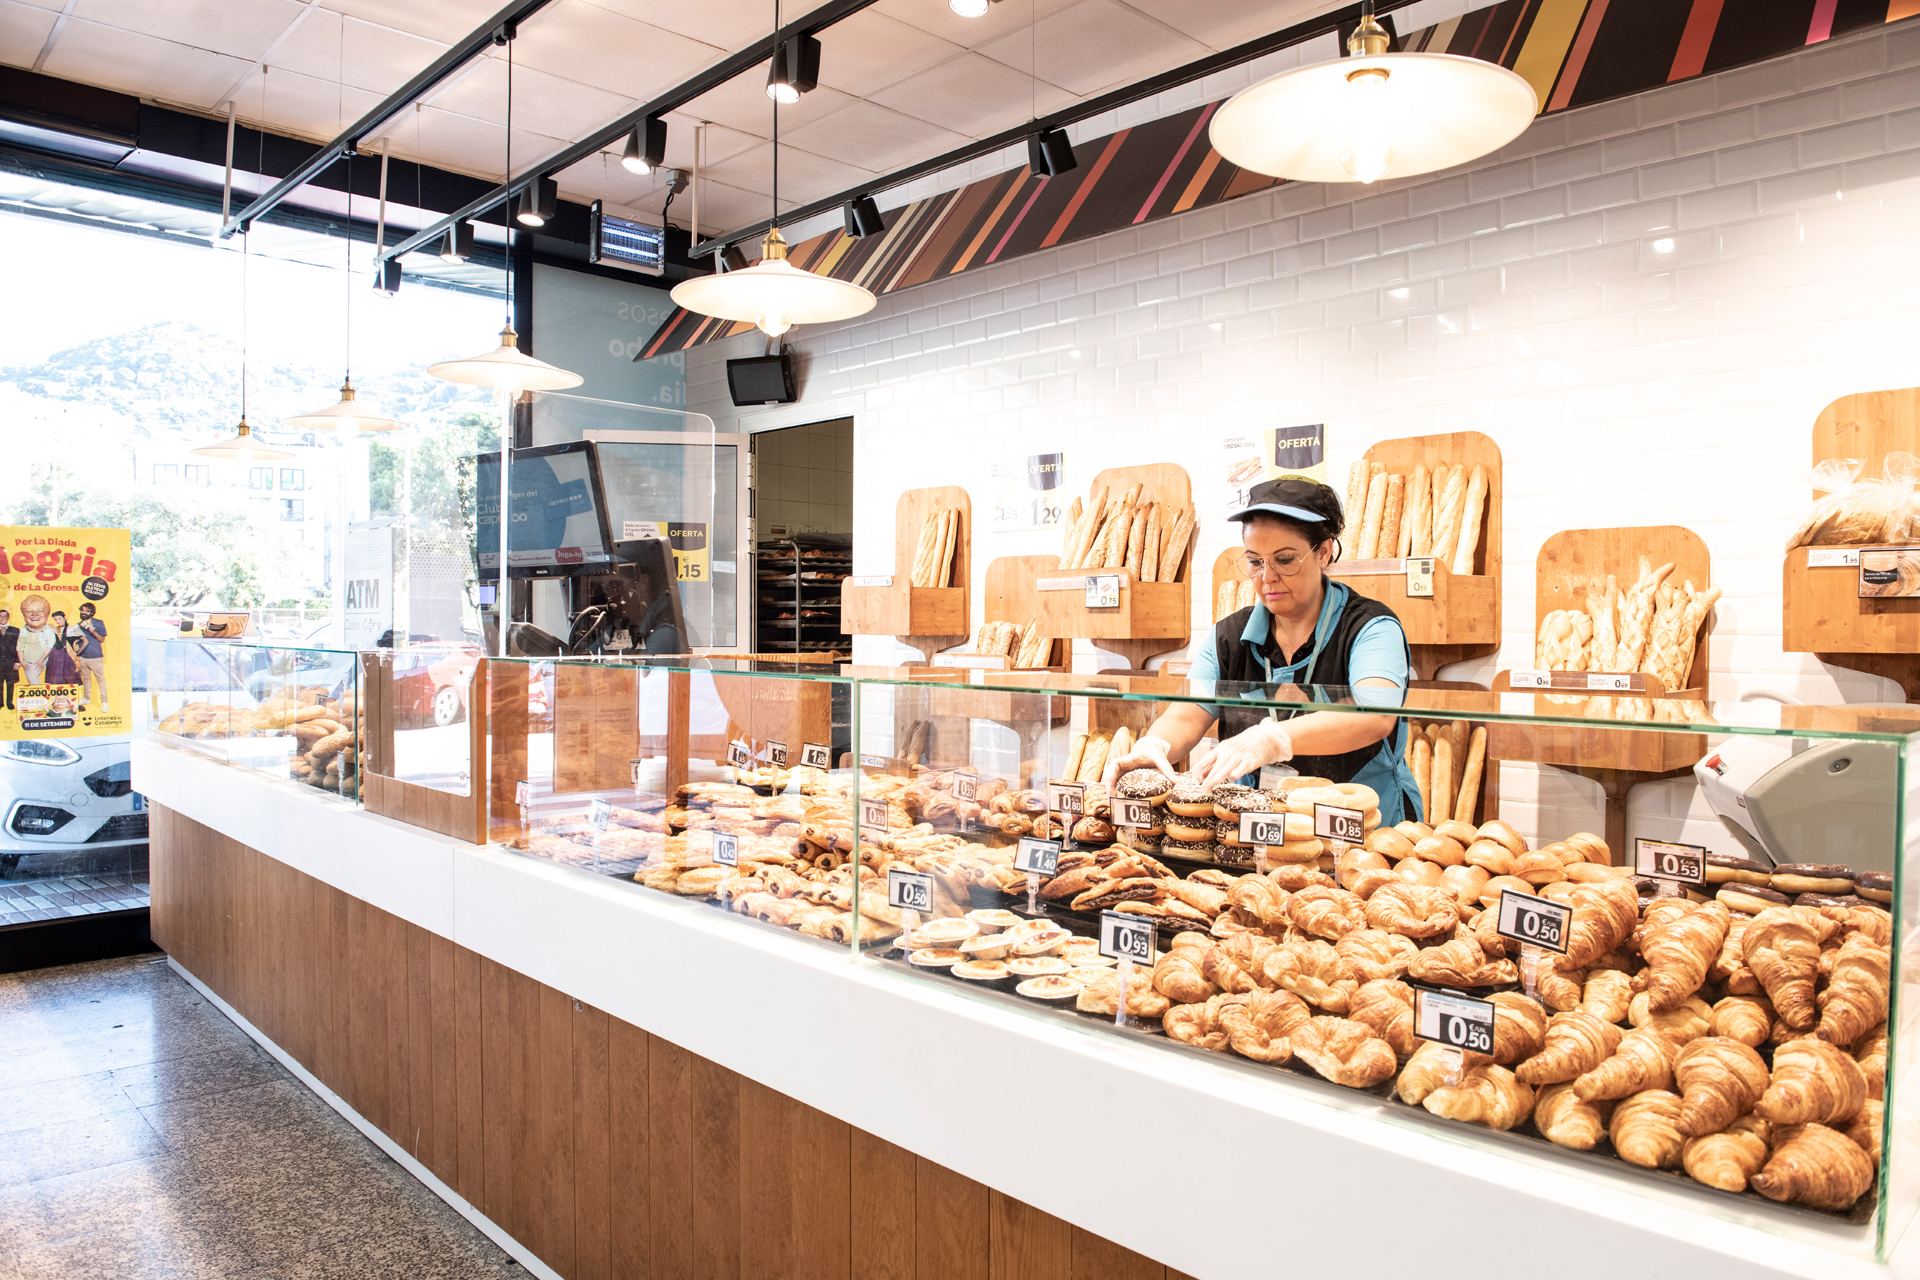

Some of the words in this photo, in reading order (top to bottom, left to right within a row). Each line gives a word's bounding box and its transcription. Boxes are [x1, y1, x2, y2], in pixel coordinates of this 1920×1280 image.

[1278, 437, 1321, 450] OFERTA
[1030, 463, 1061, 474] OFERTA
[1030, 498, 1062, 527] 1,29
[15, 538, 32, 546] Per
[47, 538, 77, 547] Diada
[670, 529, 704, 538] OFERTA
[14, 583, 27, 591] de
[43, 584, 79, 592] Grossa
[346, 579, 380, 609] ATM
[19, 689, 69, 698] 2.000.000
[70, 688, 77, 696] €
[1129, 805, 1151, 822] 0,80
[1256, 822, 1280, 841] 0,69
[1335, 816, 1361, 838] 0,85
[1034, 850, 1056, 870] 1,40
[1662, 854, 1699, 877] 0,53
[903, 883, 927, 905] 0,50
[1523, 911, 1560, 942] 0,50
[1119, 928, 1148, 956] 0,93
[1448, 1016, 1491, 1051] 0,50
[1469, 1023, 1487, 1033] €/UN.
